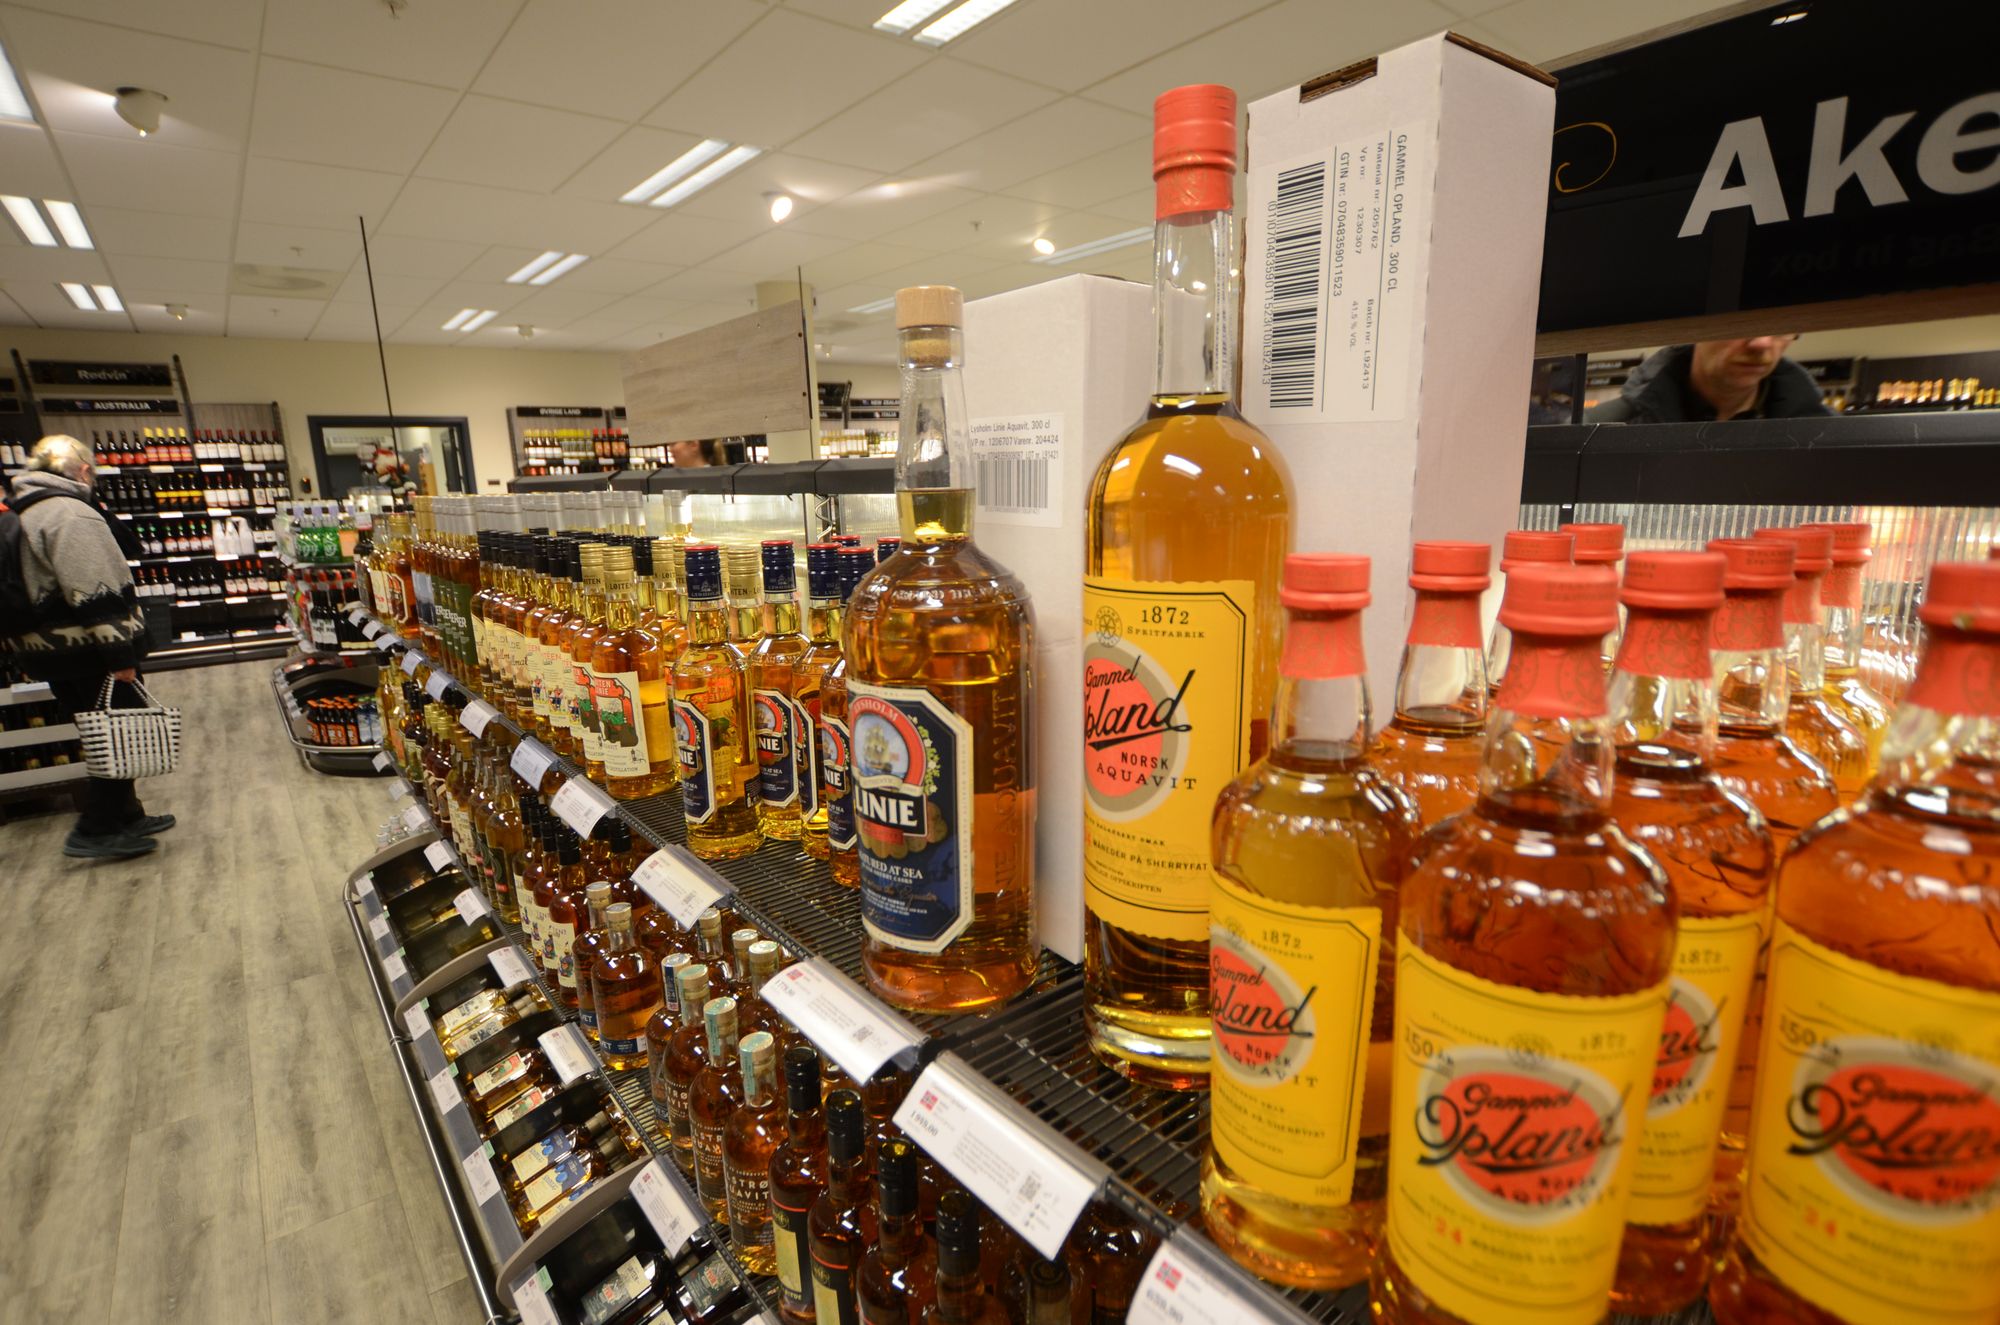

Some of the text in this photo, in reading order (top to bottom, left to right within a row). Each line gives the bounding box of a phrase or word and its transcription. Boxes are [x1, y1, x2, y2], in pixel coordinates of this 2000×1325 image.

[1358, 146, 1368, 162] Vp
[1394, 134, 1408, 191] GAMMEL
[1677, 91, 2000, 238] Ake
[1371, 142, 1384, 249] Material nr: 205762
[1333, 152, 1350, 297] GTIN nr: 07048359011523
[1354, 207, 1365, 255] 1230307
[1388, 251, 1400, 274] 300
[1387, 278, 1398, 294] CL
[1365, 298, 1375, 329] Batch
[1362, 349, 1372, 390] L92413
[94, 401, 151, 410] AUSTRALIA
[1031, 420, 1043, 430] 300
[1141, 606, 1190, 625] 1872
[1085, 655, 1142, 690] Gammel
[854, 698, 898, 722] YSHOLM
[1085, 669, 1197, 750] pland
[758, 734, 781, 752] NIE
[1120, 750, 1170, 771] NORSK
[1096, 761, 1198, 791] AQUAVIT
[889, 866, 902, 877] AT
[902, 866, 923, 880] SEA
[1130, 854, 1143, 865] PÅ
[1146, 858, 1208, 872] SHERRYFAT
[1262, 928, 1304, 950] 1872
[1211, 984, 1318, 1038] pland
[1404, 1026, 1434, 1057] 150
[1222, 1044, 1320, 1089] AQUAVIT
[1786, 1083, 2000, 1170] Oplan
